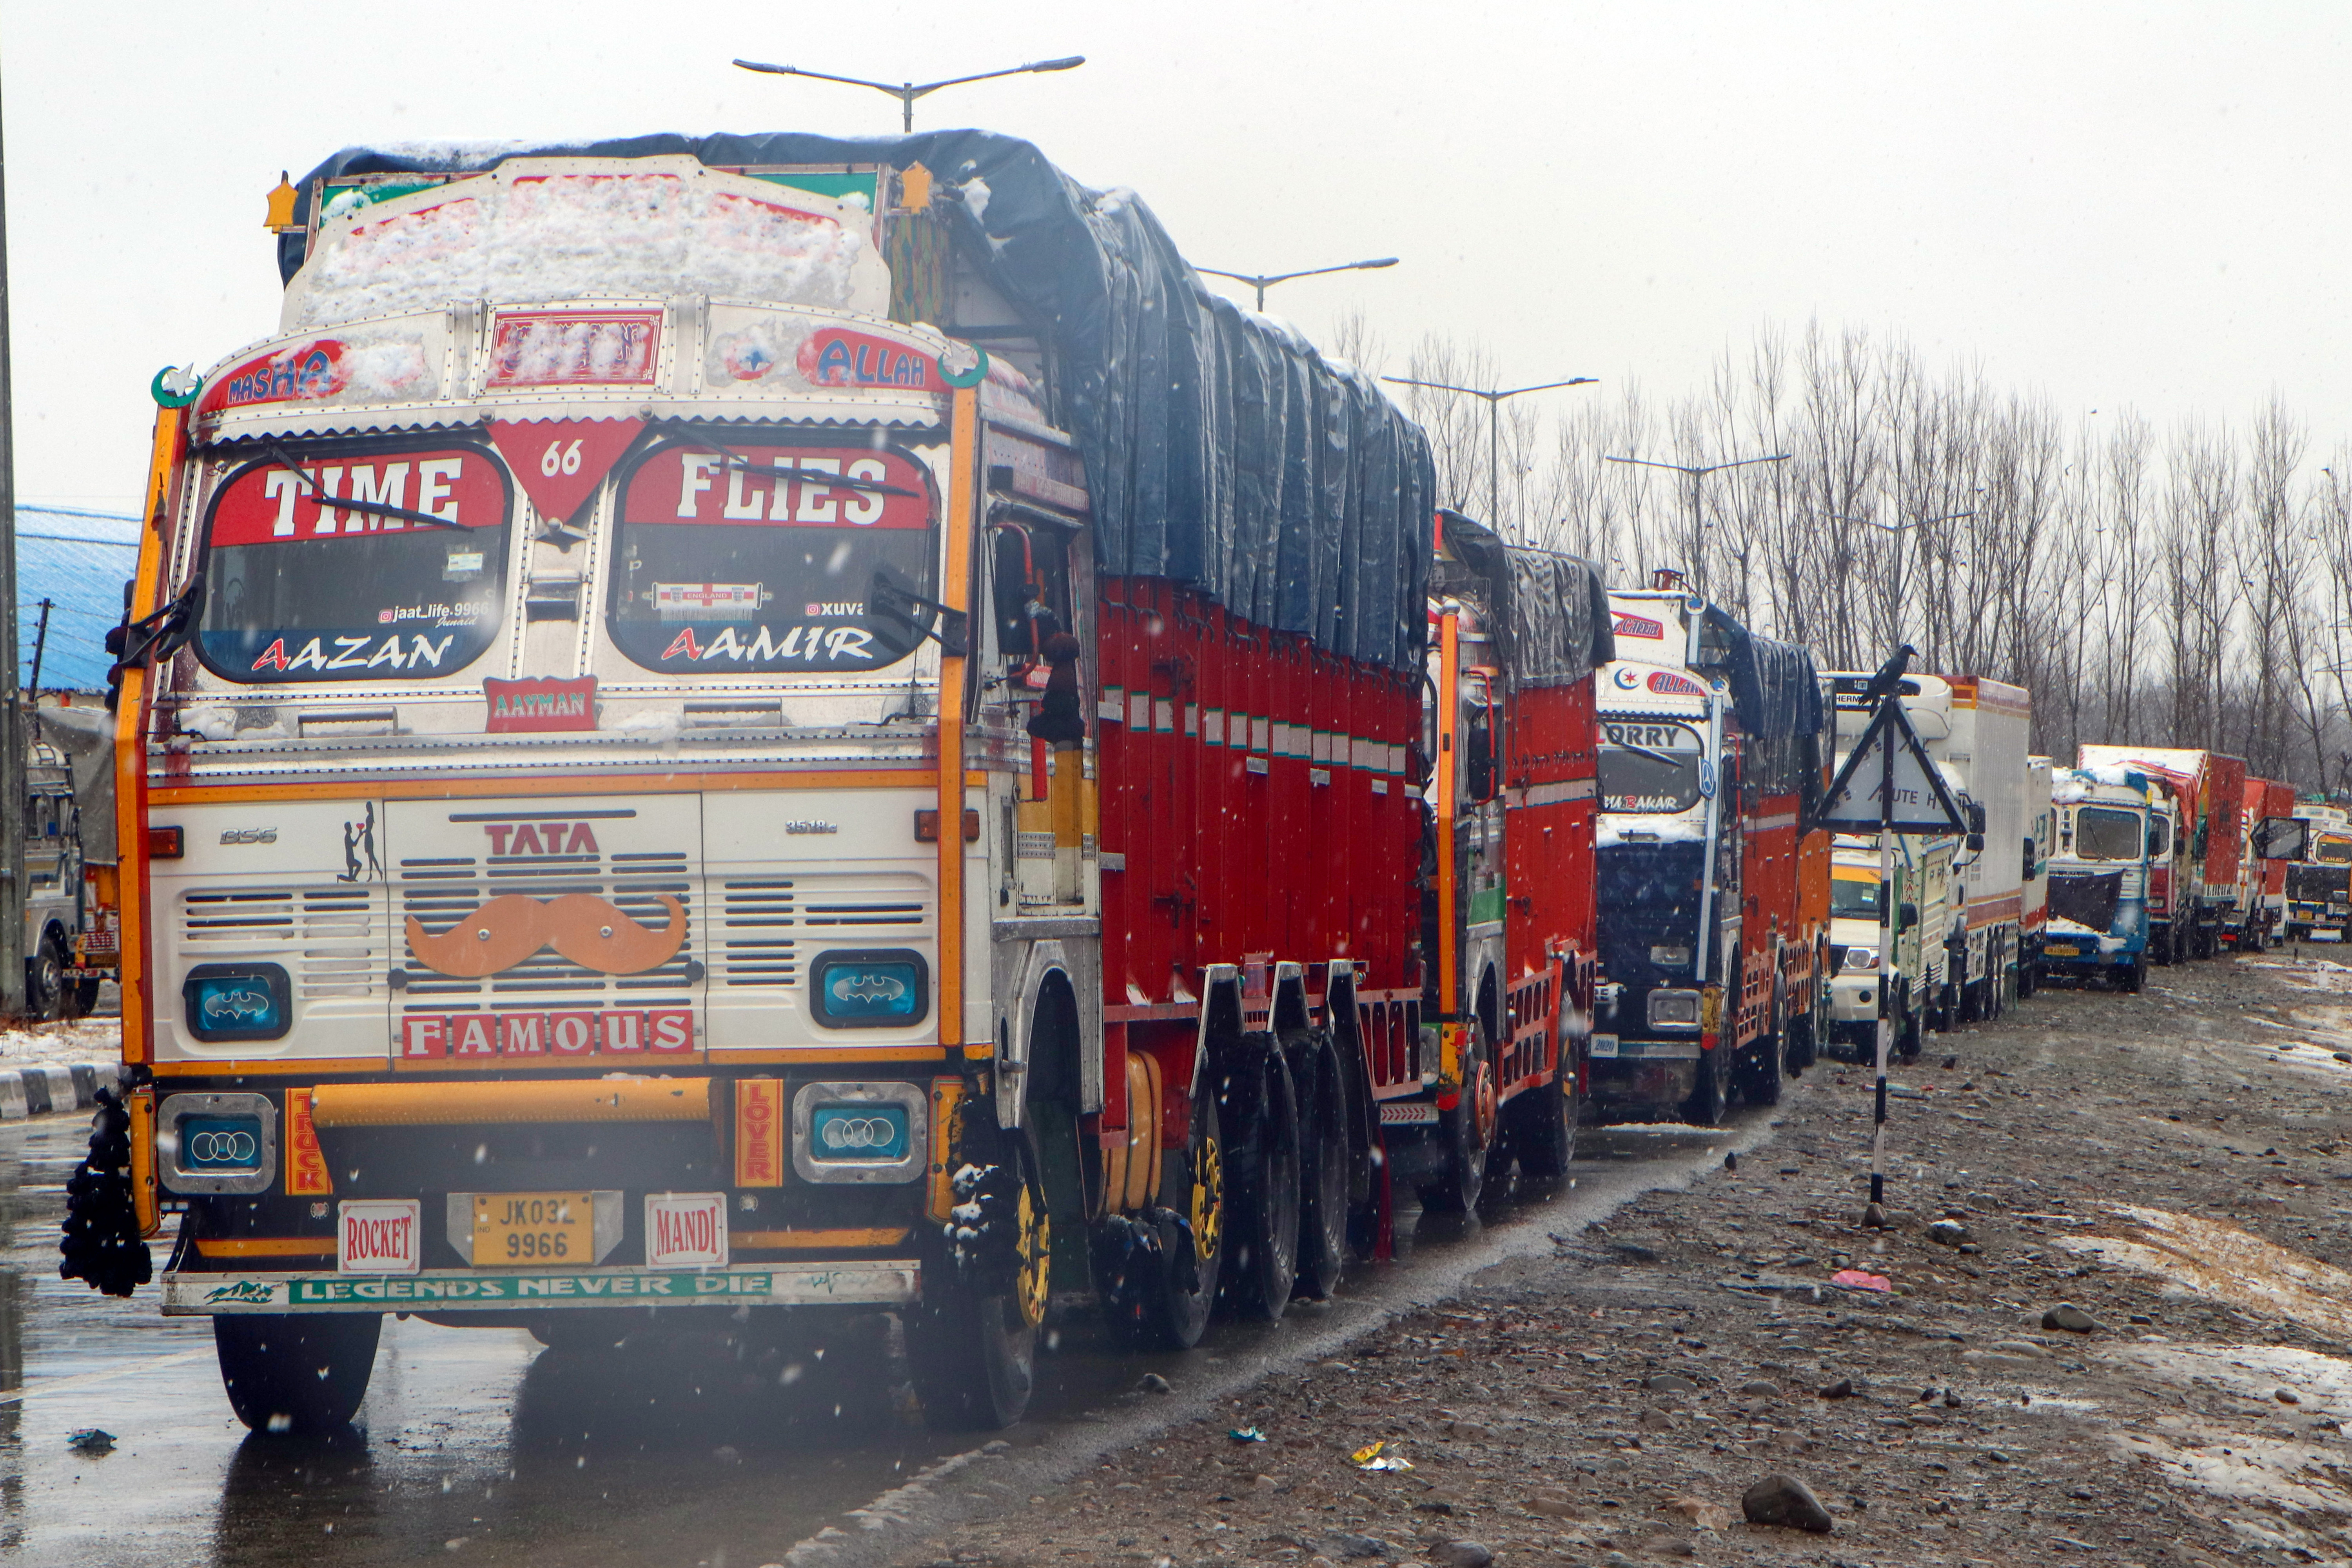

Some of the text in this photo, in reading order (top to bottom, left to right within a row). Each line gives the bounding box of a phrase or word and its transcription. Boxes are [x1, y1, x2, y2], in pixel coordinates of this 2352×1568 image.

[227, 350, 332, 404] MASHA
[817, 339, 925, 387] ALLAH
[540, 439, 584, 477] 66
[265, 454, 886, 537] TIME FLIES
[392, 603, 489, 623] jaat_life.9966
[435, 616, 478, 628] Junaid
[252, 634, 454, 671] AAZAN
[662, 625, 873, 661] AAMIR
[1653, 674, 1700, 695] ALLAH
[494, 692, 585, 718] AAYMAN
[1596, 725, 1681, 746] LORRY
[220, 827, 277, 845] BS6
[485, 823, 599, 855] TATA
[408, 1015, 686, 1056] FAMOUS
[1595, 1038, 1615, 1052] 2020
[295, 1093, 323, 1190] TRUCK
[744, 1084, 773, 1181] LOVER
[347, 1215, 411, 1261] ROCKET
[507, 1232, 567, 1258] 9966
[656, 1206, 717, 1256] MANDI
[301, 1274, 768, 1301] LEGENDS NEVER DIE
